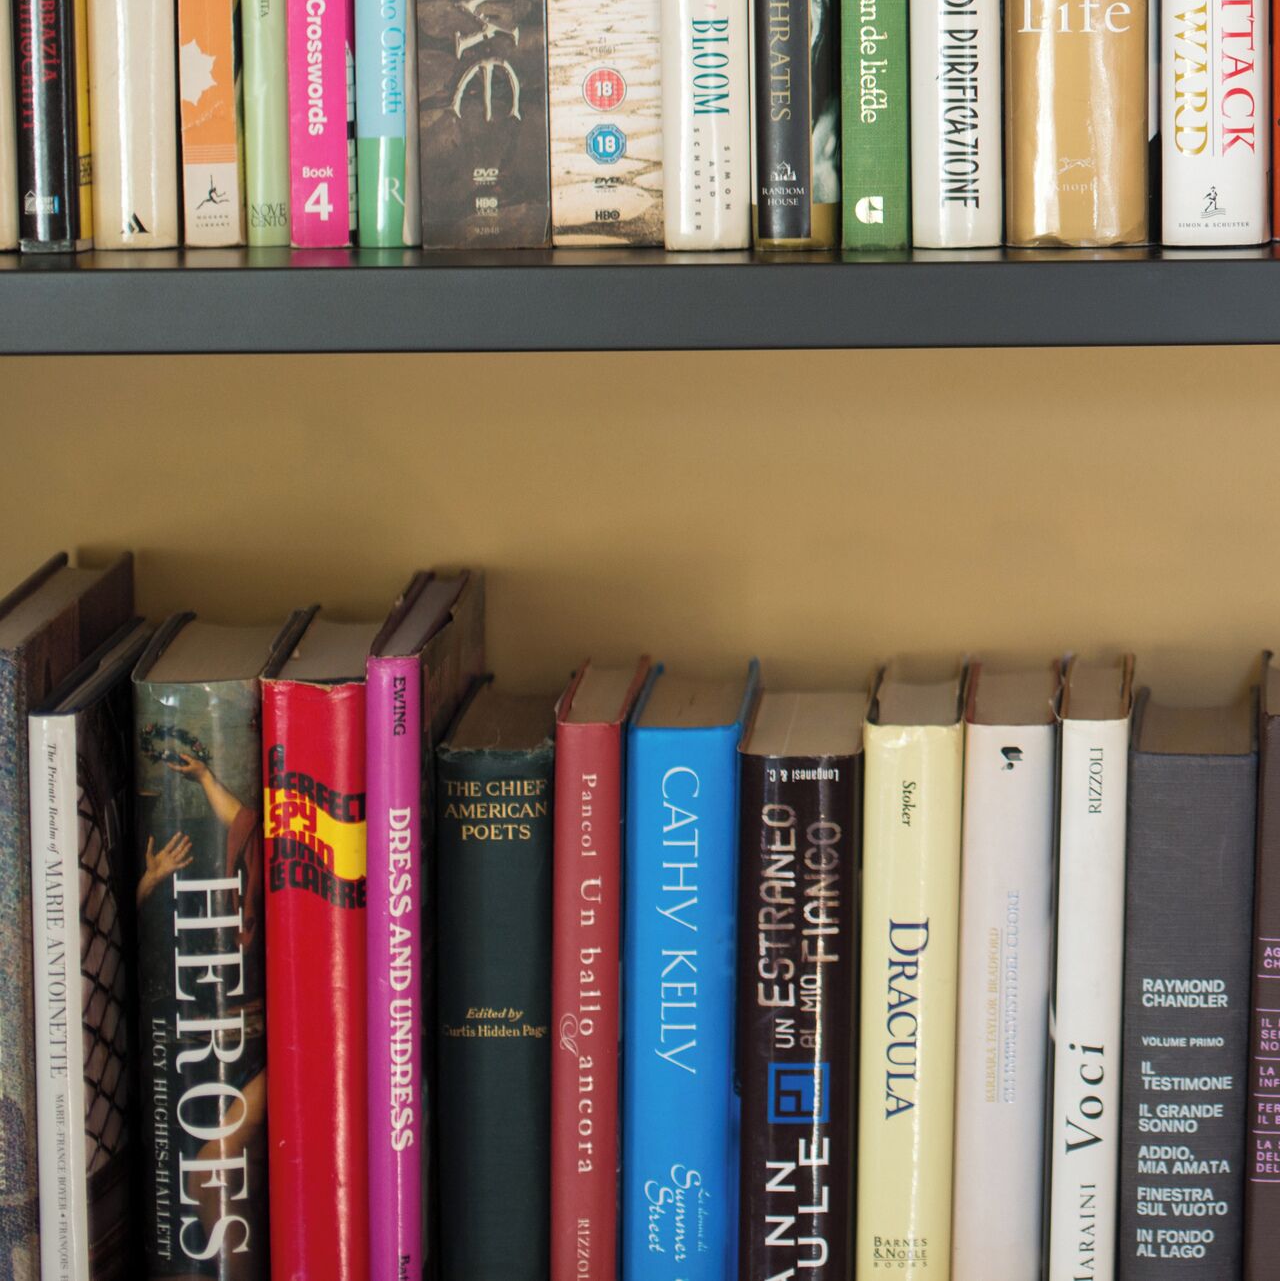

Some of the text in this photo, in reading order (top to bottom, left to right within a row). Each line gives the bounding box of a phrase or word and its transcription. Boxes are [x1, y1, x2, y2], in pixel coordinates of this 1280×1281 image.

[692, 17, 730, 116] BLOOM
[595, 81, 612, 97] 18
[597, 137, 616, 152] 18
[302, 167, 333, 178] Book
[762, 187, 804, 195] RANDOM
[304, 182, 333, 221] 4
[768, 198, 799, 206] HOUSE
[595, 211, 620, 220] HBO
[393, 677, 406, 736] EWING
[445, 779, 547, 797] THE CHIEF
[1089, 747, 1104, 814] RIZZOLI
[444, 801, 547, 819] AMERICAN
[900, 780, 916, 827] Stoker
[580, 773, 597, 857] Pancol
[460, 823, 532, 841] POETS
[656, 766, 699, 1074] CATHY KELLY
[45, 860, 69, 1079] MARIE ANTOINETTE
[388, 808, 414, 1153] DRESS AND UNDRESS
[1142, 978, 1225, 993] RAYMOND
[1141, 992, 1228, 1008] CHANDLER
[577, 878, 601, 1173] Un ballo ancora
[886, 917, 929, 1120] DRACULA
[1141, 1036, 1224, 1047] VOLUME PRIMO
[173, 871, 250, 1262] HEROES
[1142, 1075, 1232, 1091] TESTIMONE
[1066, 1043, 1104, 1155] Voci
[1138, 1118, 1198, 1133] SONNO
[1138, 1159, 1230, 1174] MIA AMATA
[1137, 1187, 1213, 1202] FINESTRA
[1137, 1228, 1214, 1243] IN FONDO
